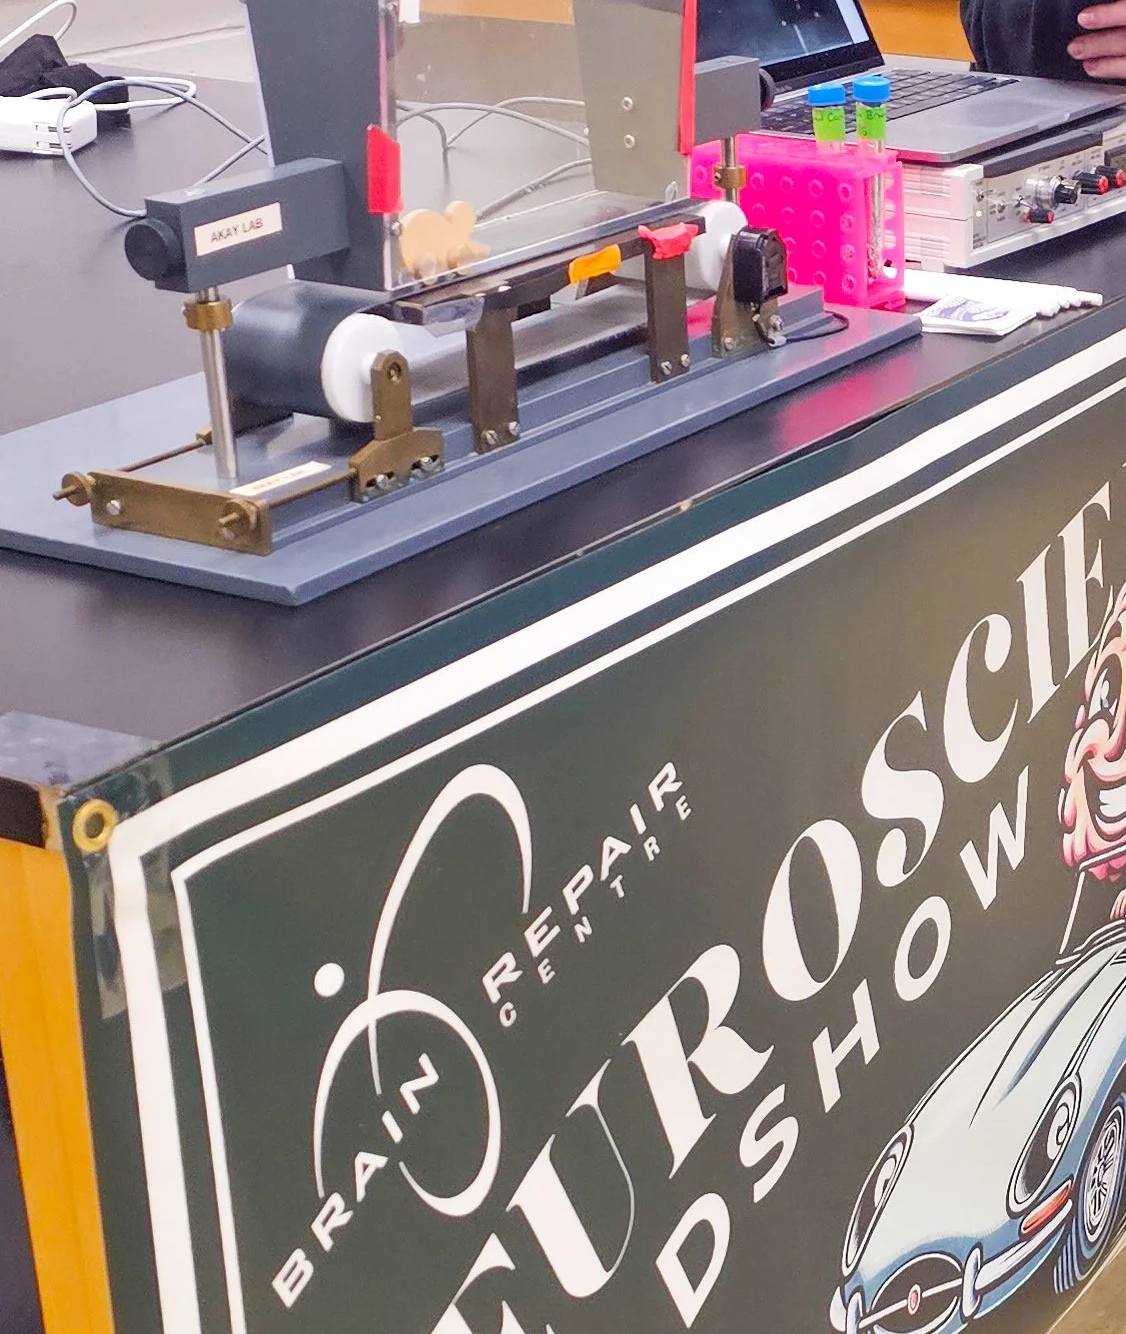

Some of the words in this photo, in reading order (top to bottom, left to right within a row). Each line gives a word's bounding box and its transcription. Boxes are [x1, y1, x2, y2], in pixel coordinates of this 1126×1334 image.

[210, 223, 240, 243] AKAY
[242, 217, 264, 233] LAB
[499, 795, 692, 1028] CENTRE
[271, 1052, 440, 1309] BRAIN
[482, 761, 683, 1004] REPAIR
